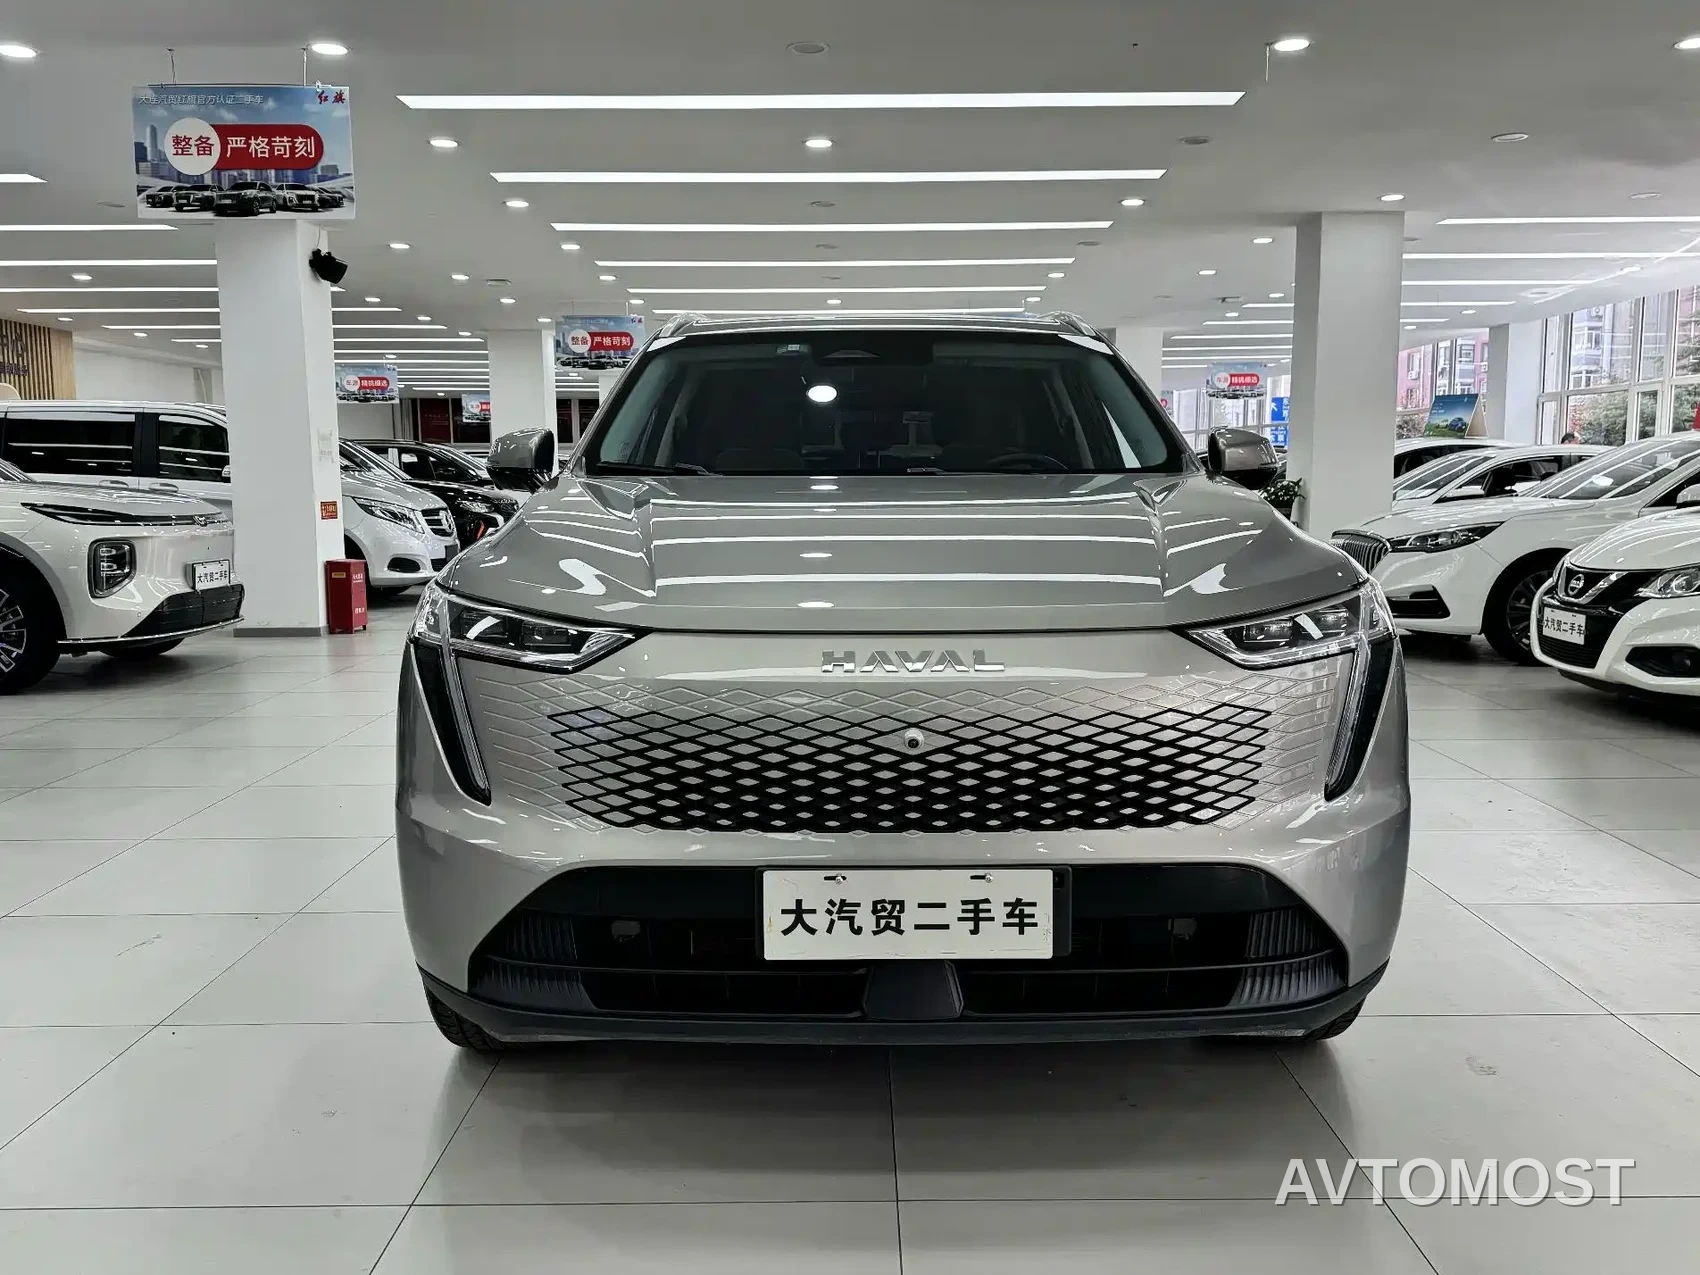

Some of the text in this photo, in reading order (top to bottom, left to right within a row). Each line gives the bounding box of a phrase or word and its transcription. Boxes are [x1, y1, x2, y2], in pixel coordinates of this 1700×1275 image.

[171, 134, 316, 158] 整备 严格苛刻
[1544, 616, 1585, 638] 大汽贸二手车
[820, 649, 1006, 673] HAVAL
[780, 897, 1039, 936] 大汽贸二手车
